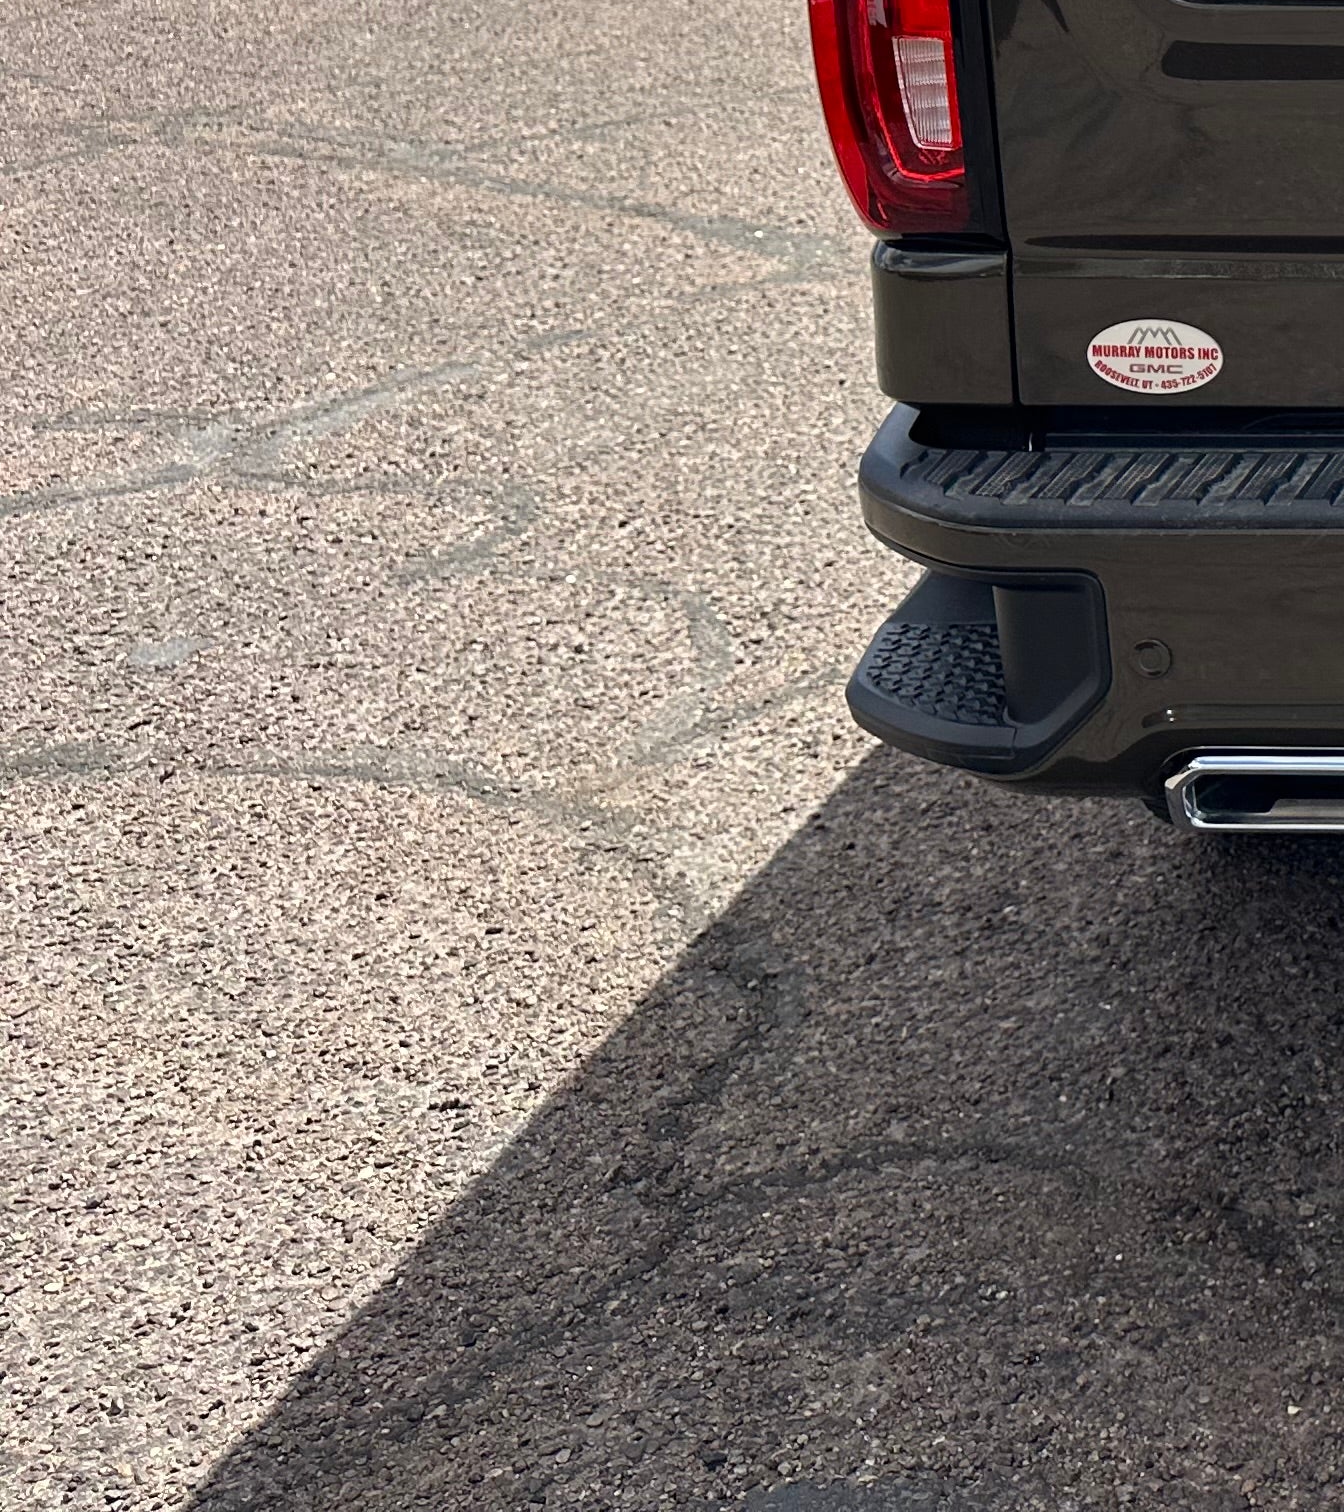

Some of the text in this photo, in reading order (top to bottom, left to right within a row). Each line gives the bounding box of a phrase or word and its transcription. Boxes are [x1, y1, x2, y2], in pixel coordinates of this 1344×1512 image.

[1092, 344, 1219, 361] MURRAY MOTORS INC
[1129, 363, 1184, 375] GMC
[1142, 379, 1154, 390] UT
[1160, 363, 1218, 390] 435-722-5107
